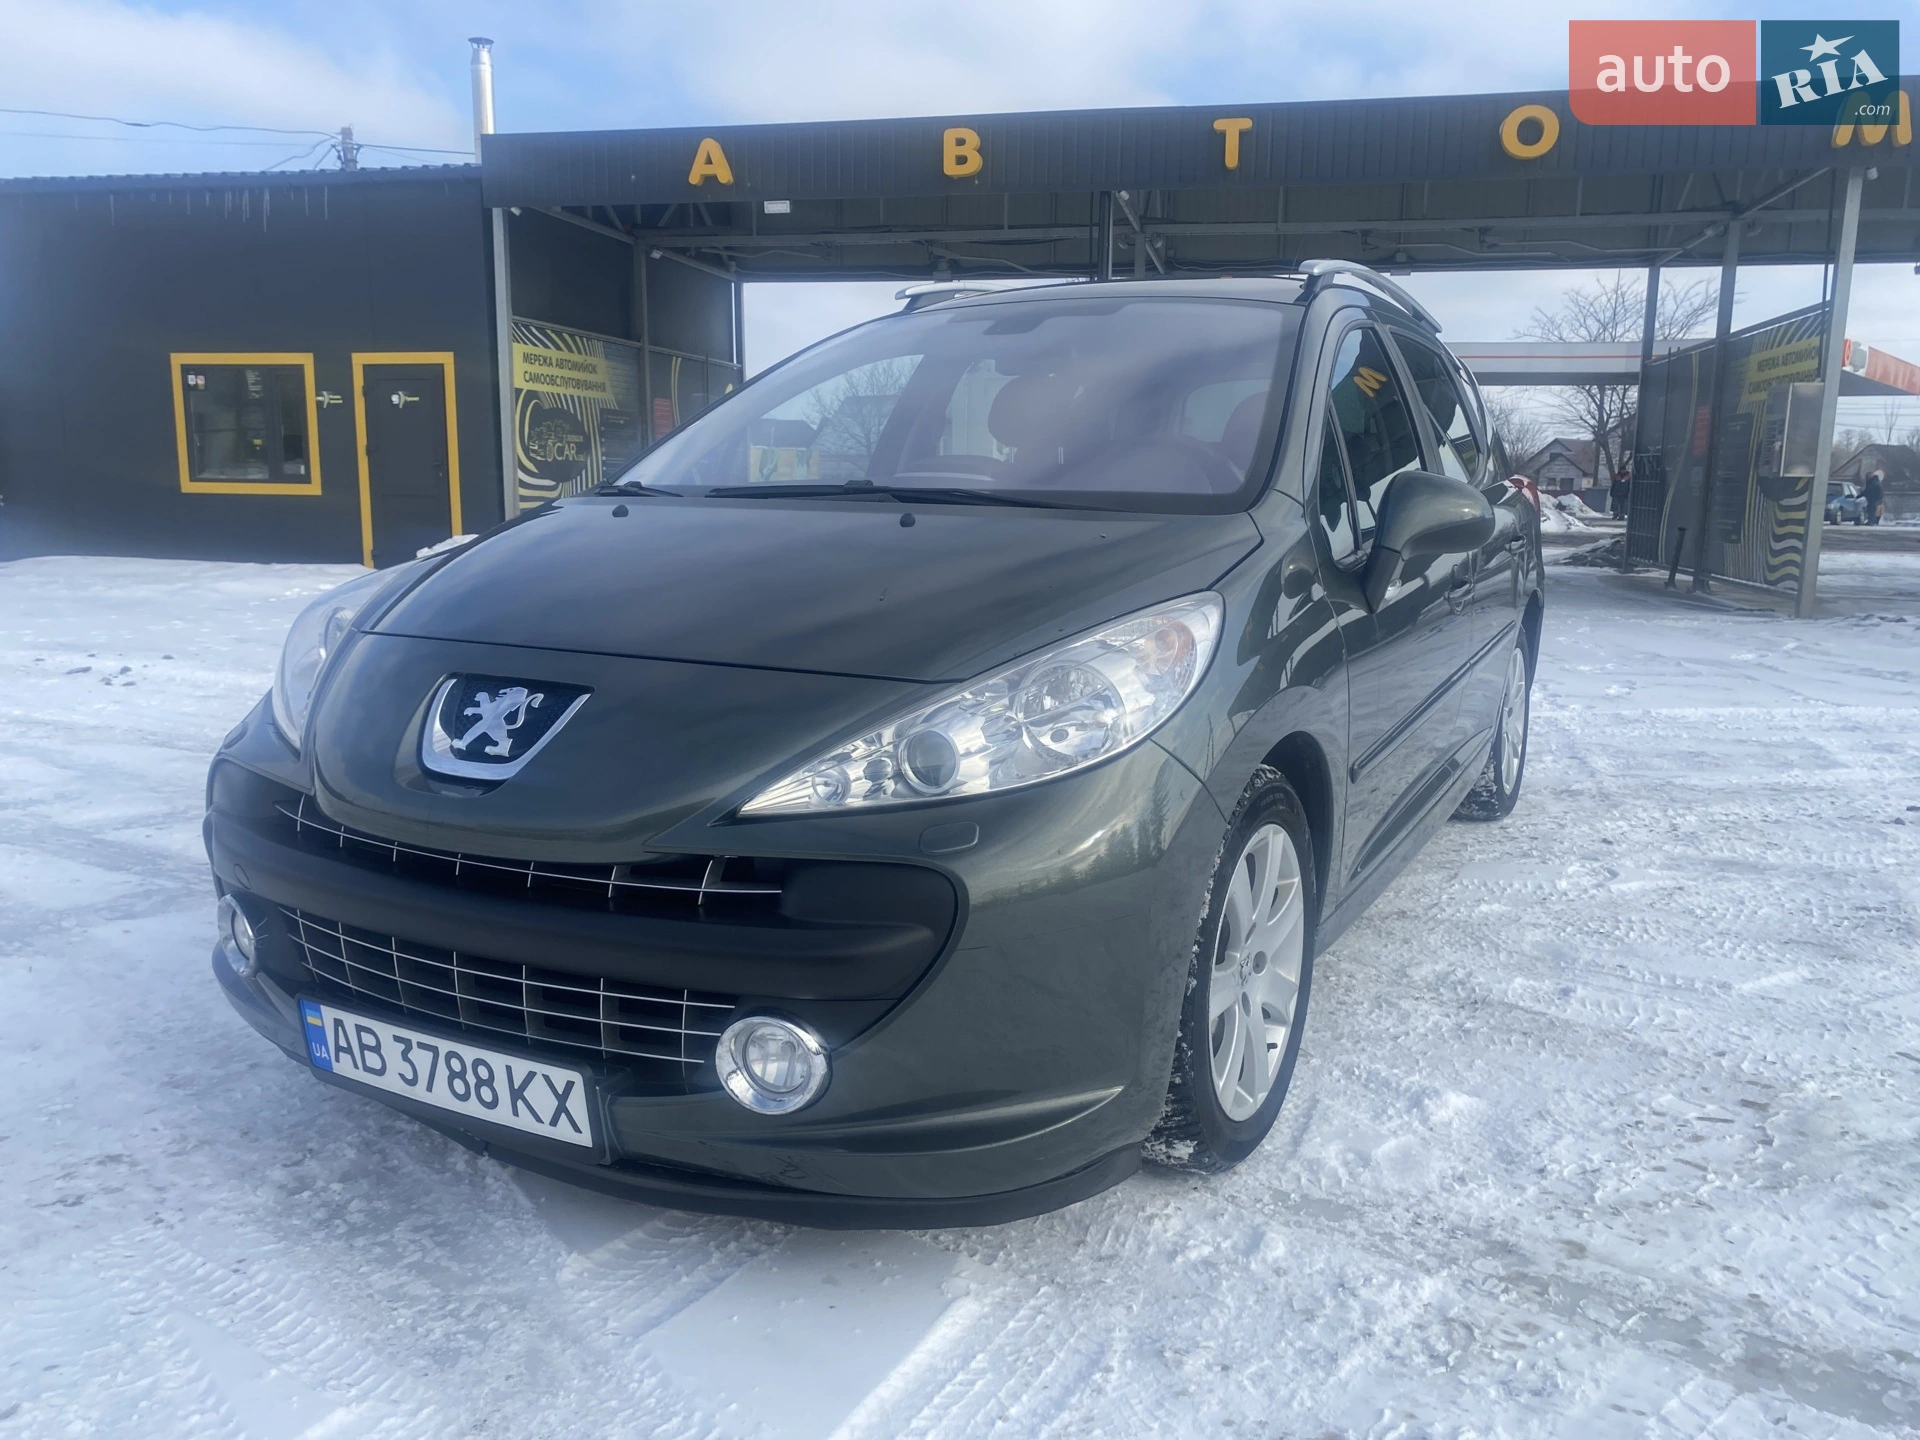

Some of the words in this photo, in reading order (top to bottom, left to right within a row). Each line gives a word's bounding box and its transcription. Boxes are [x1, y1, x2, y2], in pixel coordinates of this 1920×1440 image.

[522, 352, 554, 369] МЕРЕЖА
[555, 357, 598, 375] АВТОМИЙОК
[311, 1041, 330, 1061] UA
